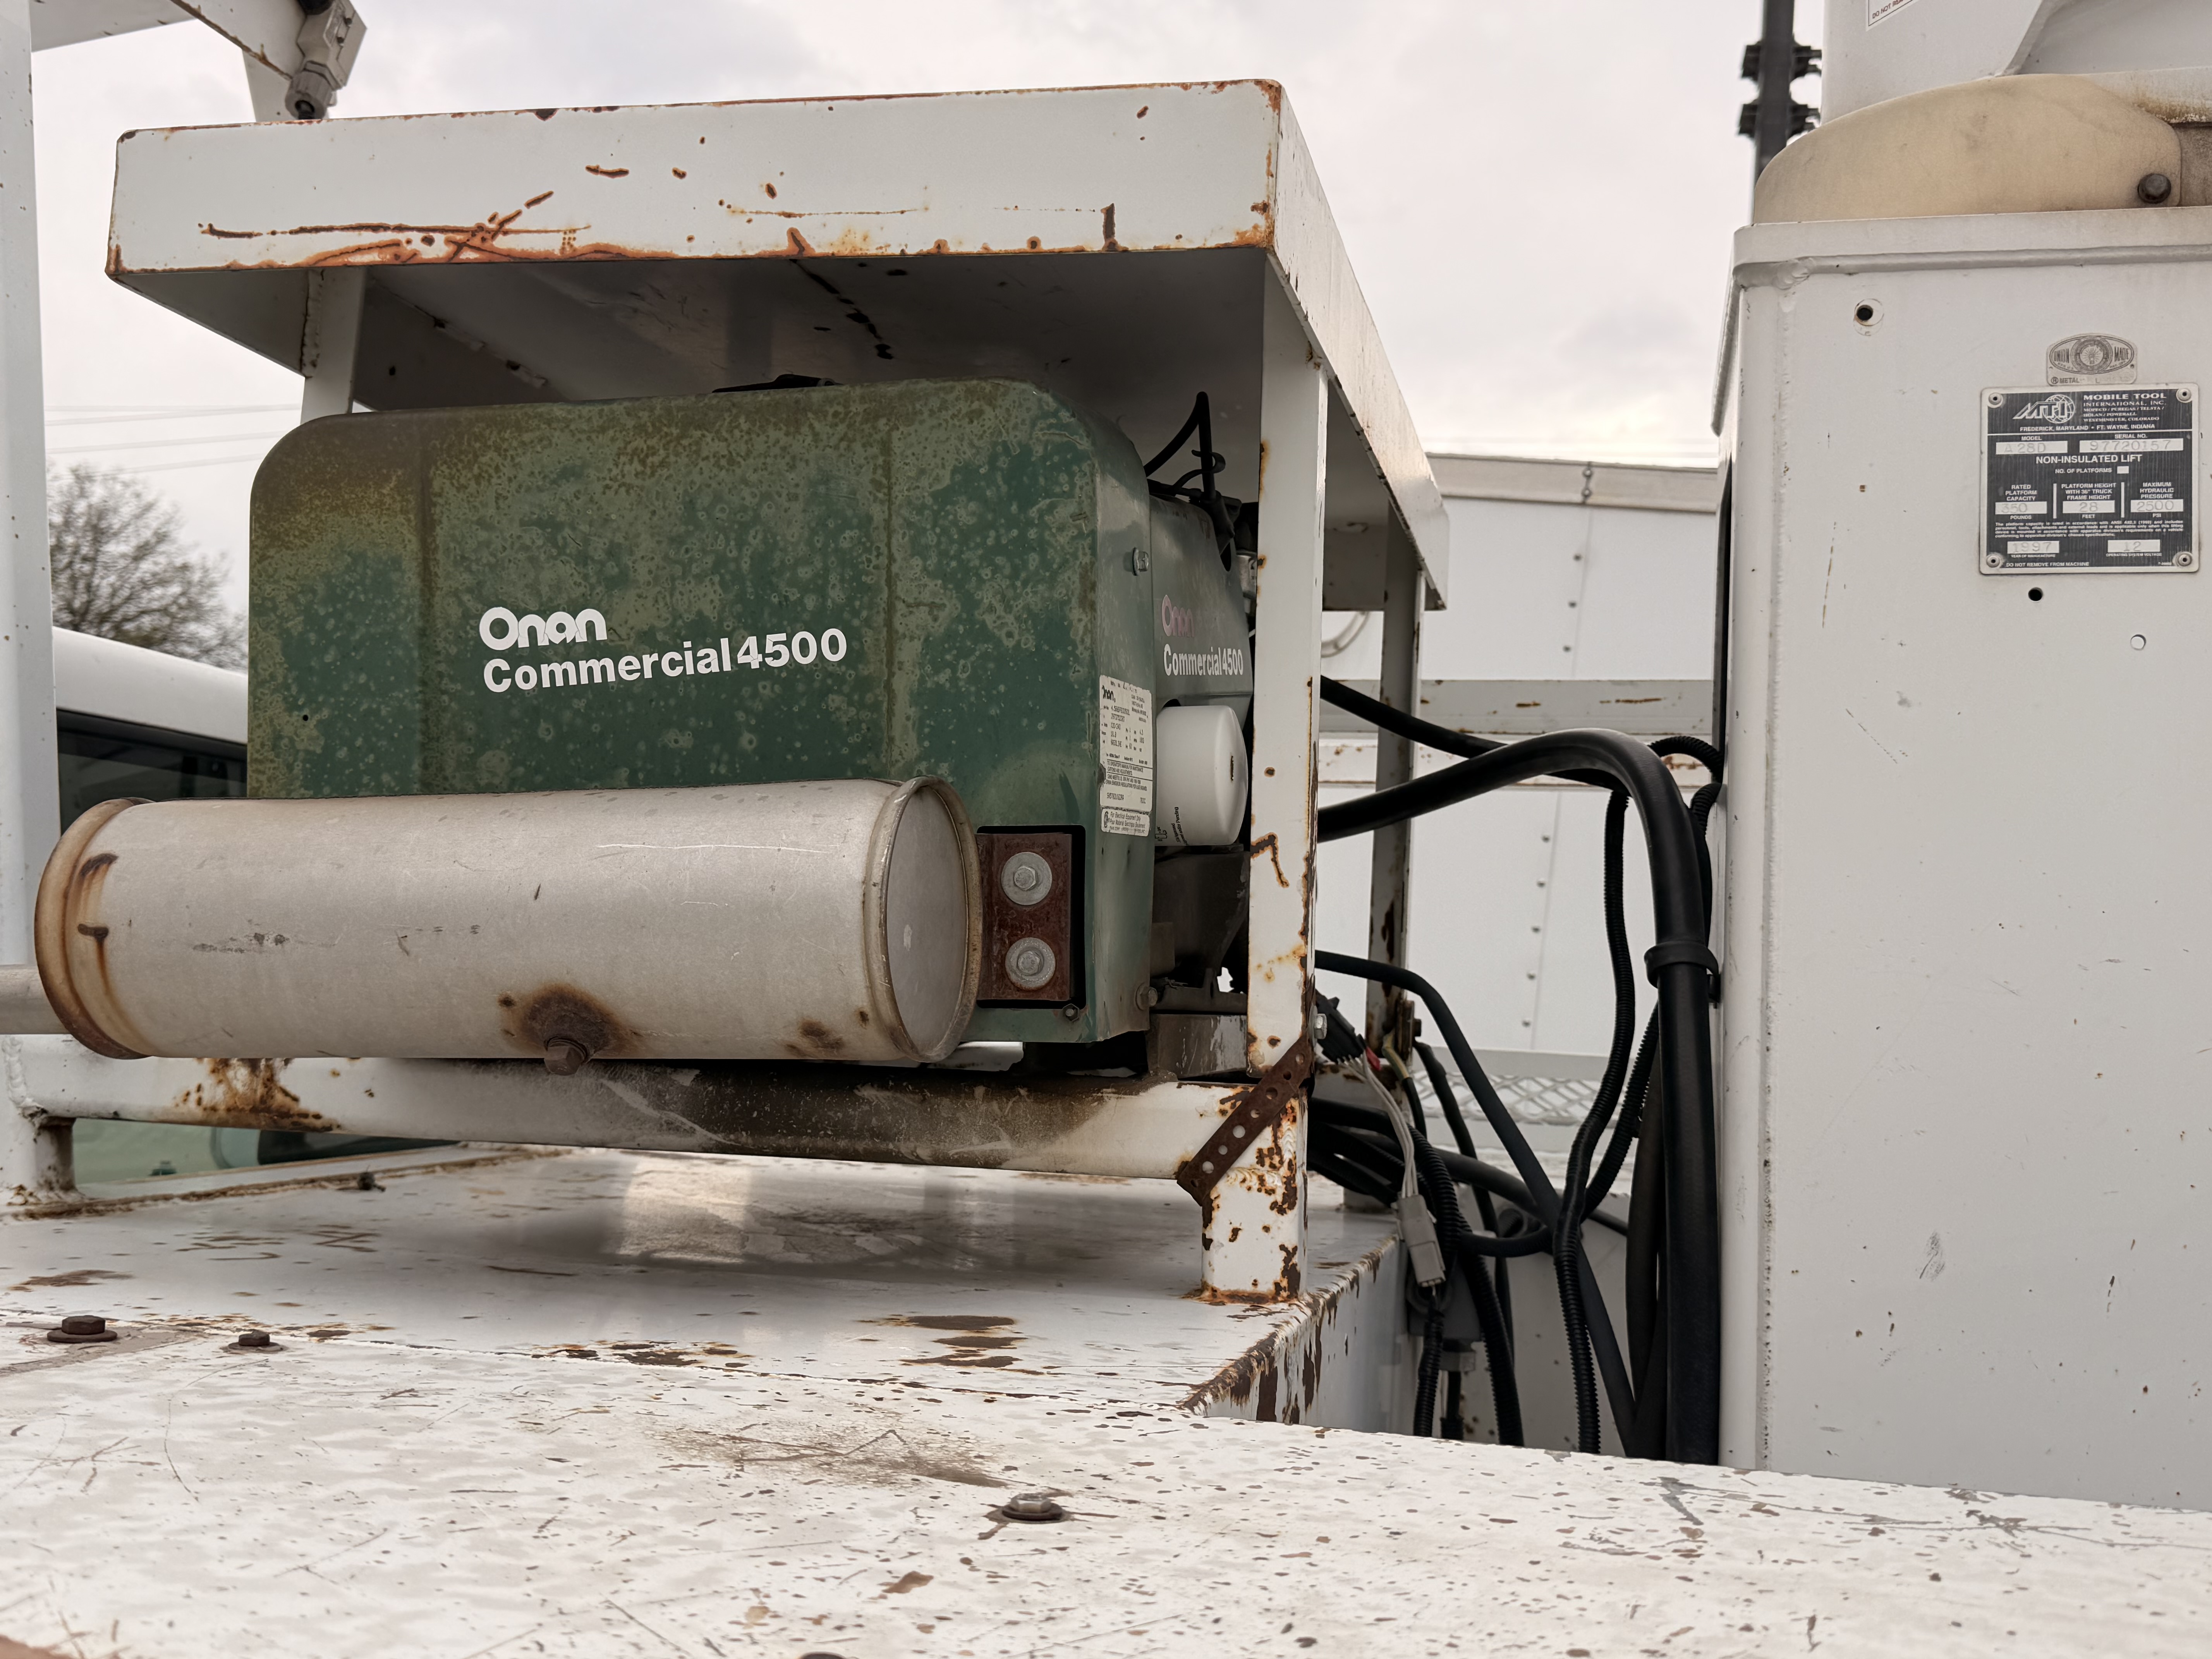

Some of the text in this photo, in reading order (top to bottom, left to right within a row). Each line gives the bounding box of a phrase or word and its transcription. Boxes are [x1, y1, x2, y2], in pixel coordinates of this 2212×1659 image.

[1872, 10, 1879, 19] DO
[1881, 3, 1891, 14] NOT
[2054, 349, 2069, 363] UNION
[2114, 347, 2129, 362] MADE
[2090, 440, 2171, 451] 97720157
[2036, 455, 2118, 464] NON-INSULATED
[2001, 503, 2028, 513] 350
[2080, 502, 2098, 512] 28
[2137, 500, 2174, 512] 2500
[2013, 542, 2051, 553] 1997
[2124, 541, 2142, 551] 12
[1162, 594, 1195, 638] Onan
[479, 607, 607, 651] Onan
[484, 628, 847, 692] Commercial 4500
[1163, 644, 1243, 676] Commercial 4500
